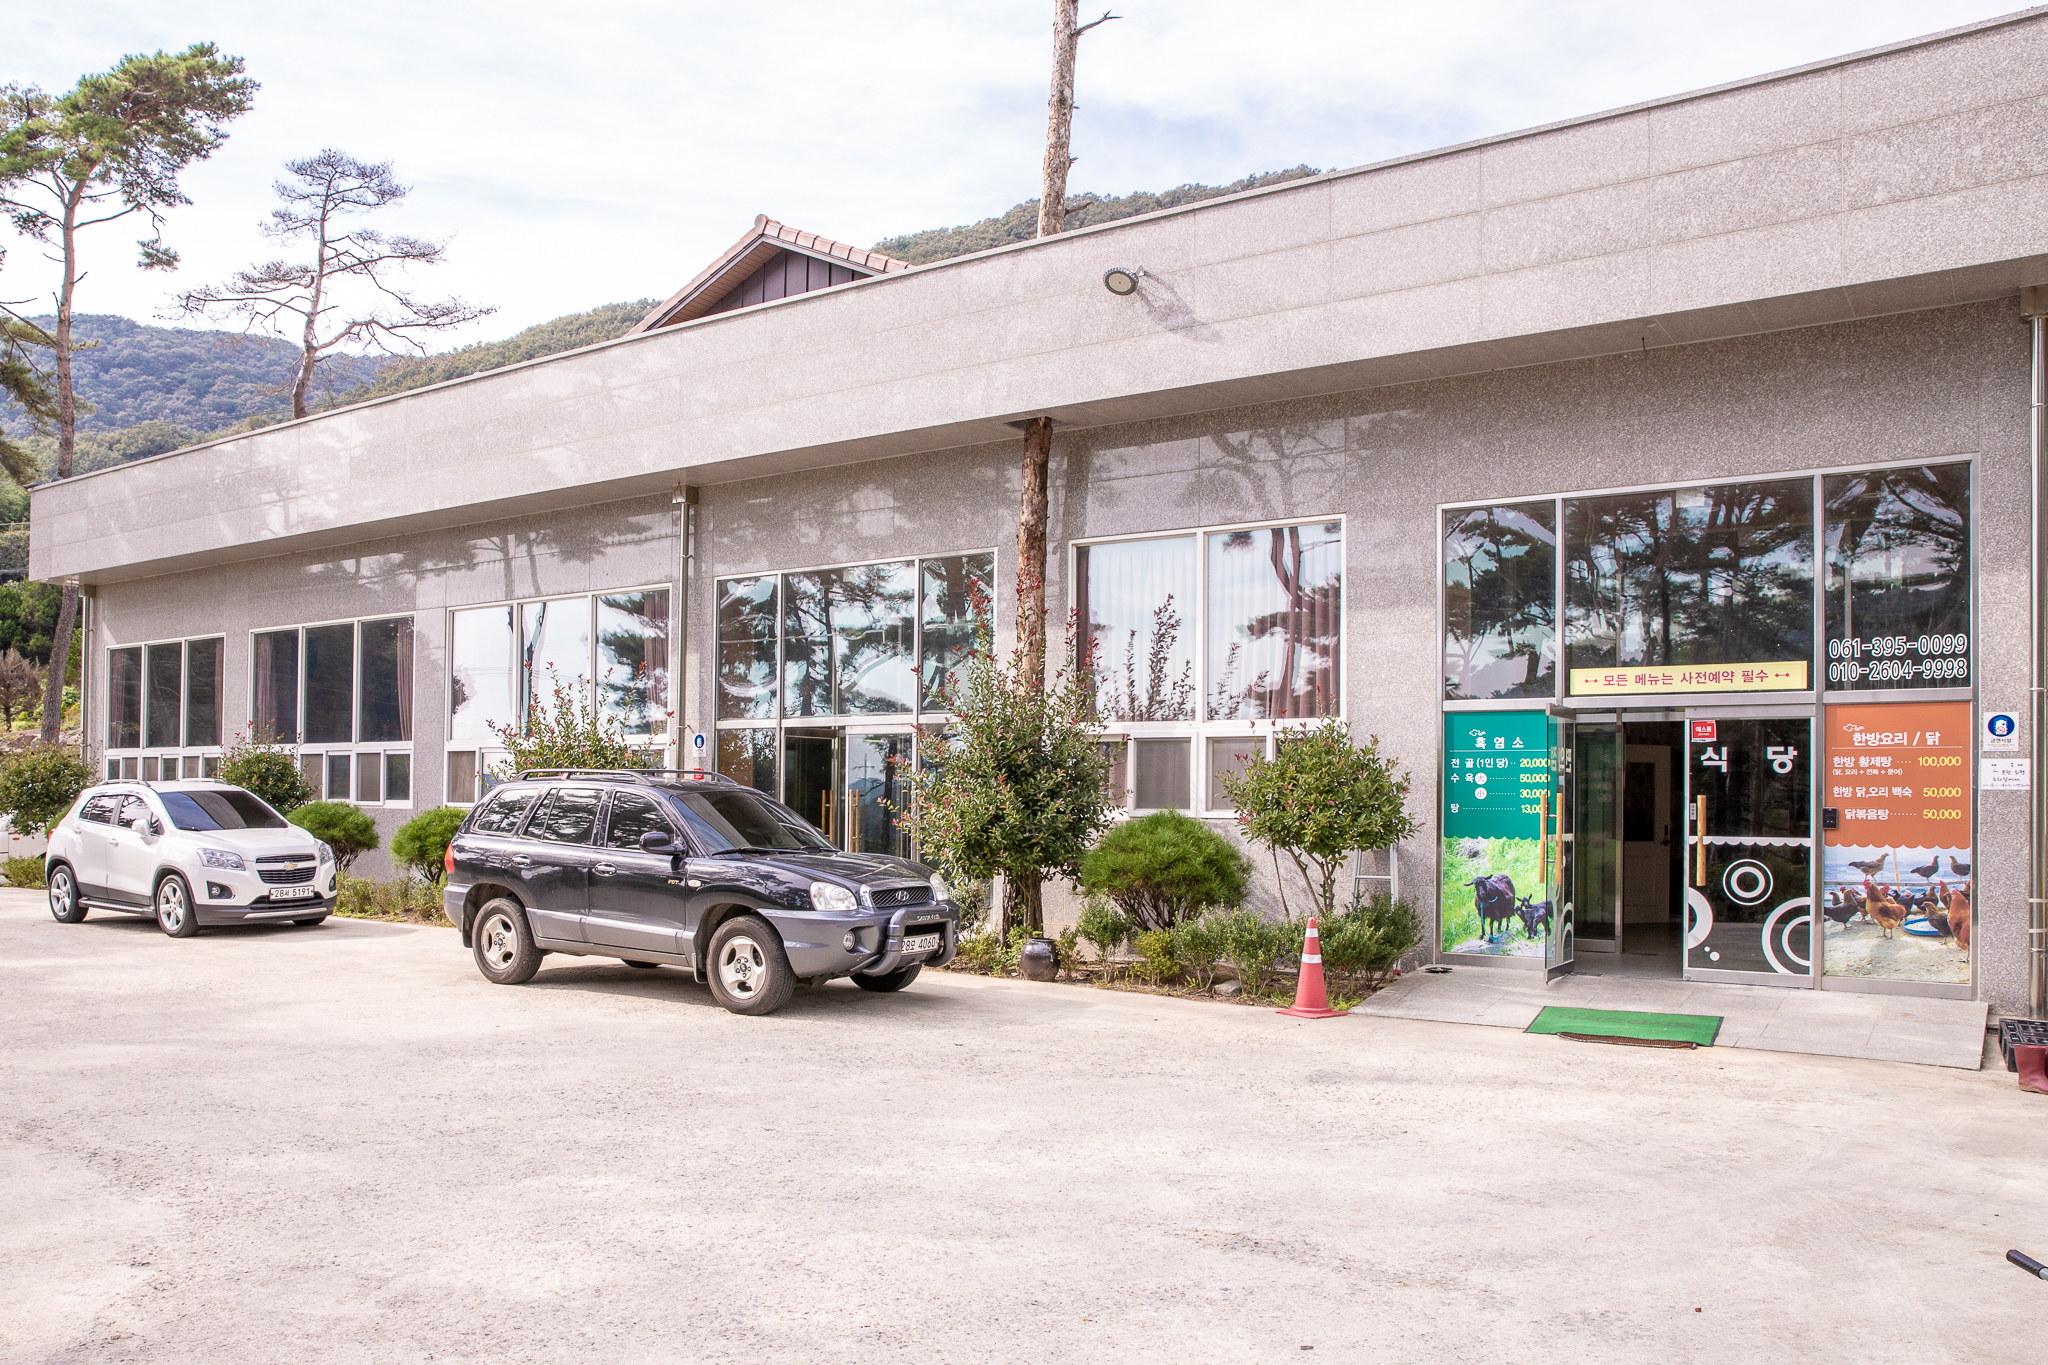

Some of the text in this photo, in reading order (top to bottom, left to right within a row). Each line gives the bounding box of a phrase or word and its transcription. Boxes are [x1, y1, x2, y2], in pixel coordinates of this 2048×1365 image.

[1828, 633, 1968, 659] 061-395-0099
[1828, 657, 1968, 682] 010-2604-9998
[1603, 669, 1769, 687] 모든 메뉴는 사전예약 필수
[1852, 731, 1908, 747] 한방요리
[1925, 731, 1941, 746] 닭
[1519, 757, 1551, 769] 20,000
[1832, 755, 1962, 768] 한방 황제탕 100,000
[1519, 773, 1551, 784] 50,000
[1844, 768, 1858, 776] 오리
[1866, 768, 1879, 776] 전복
[1832, 786, 1962, 799] 한방 닭,오리 백숙 50,000
[1450, 803, 1547, 814] 탕 13,00
[1844, 808, 1962, 820] 닭볶음탕 50,000
[292, 887, 310, 897] 5191
[918, 936, 936, 950] 4060
